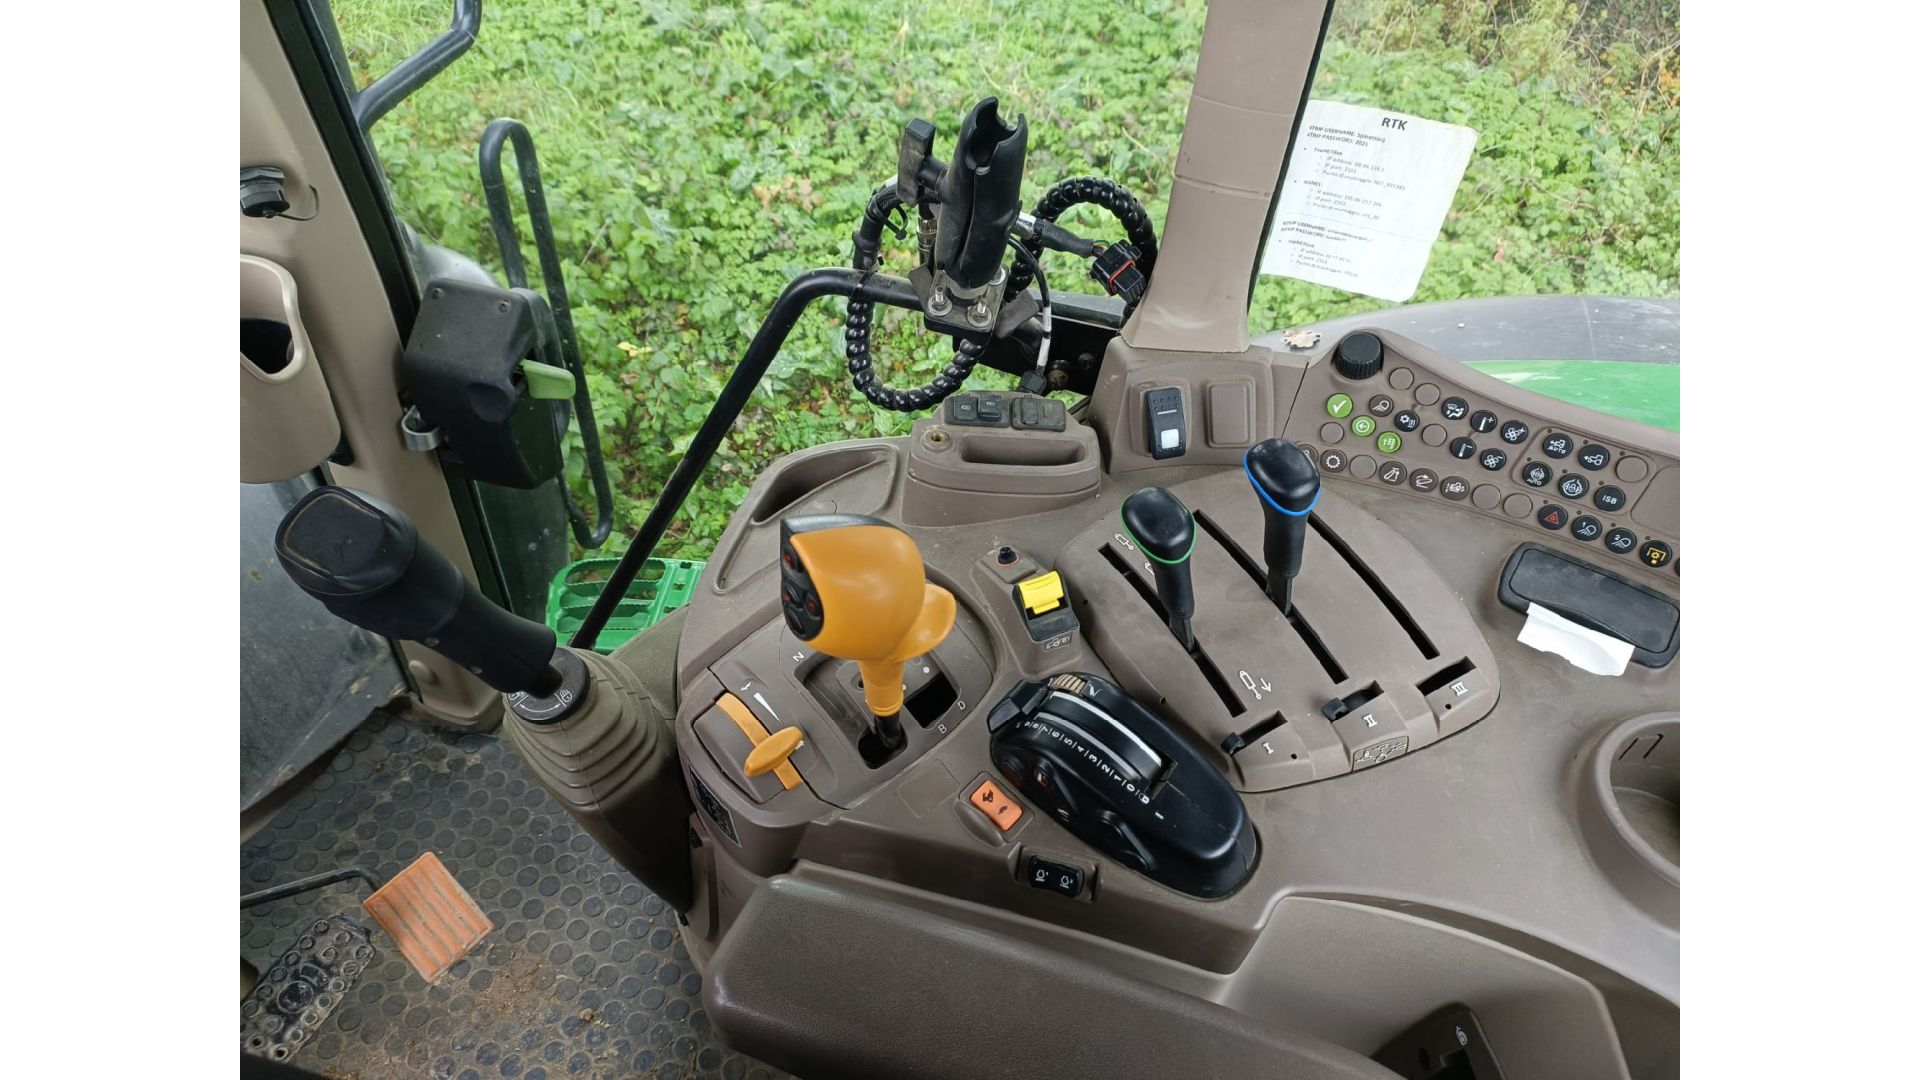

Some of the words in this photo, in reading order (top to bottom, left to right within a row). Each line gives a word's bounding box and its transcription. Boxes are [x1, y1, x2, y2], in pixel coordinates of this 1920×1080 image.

[1381, 117, 1408, 131] RTK
[1548, 445, 1566, 454] AUTO
[1526, 478, 1542, 486] AUTO
[1602, 494, 1618, 504] ISB
[792, 652, 805, 662] N
[956, 700, 966, 711] D
[937, 723, 948, 734] B
[1052, 730, 1060, 738] 6
[1064, 737, 1072, 746] 5
[1088, 754, 1098, 762] 3
[1101, 764, 1111, 773] 2
[1126, 783, 1135, 792] 0
